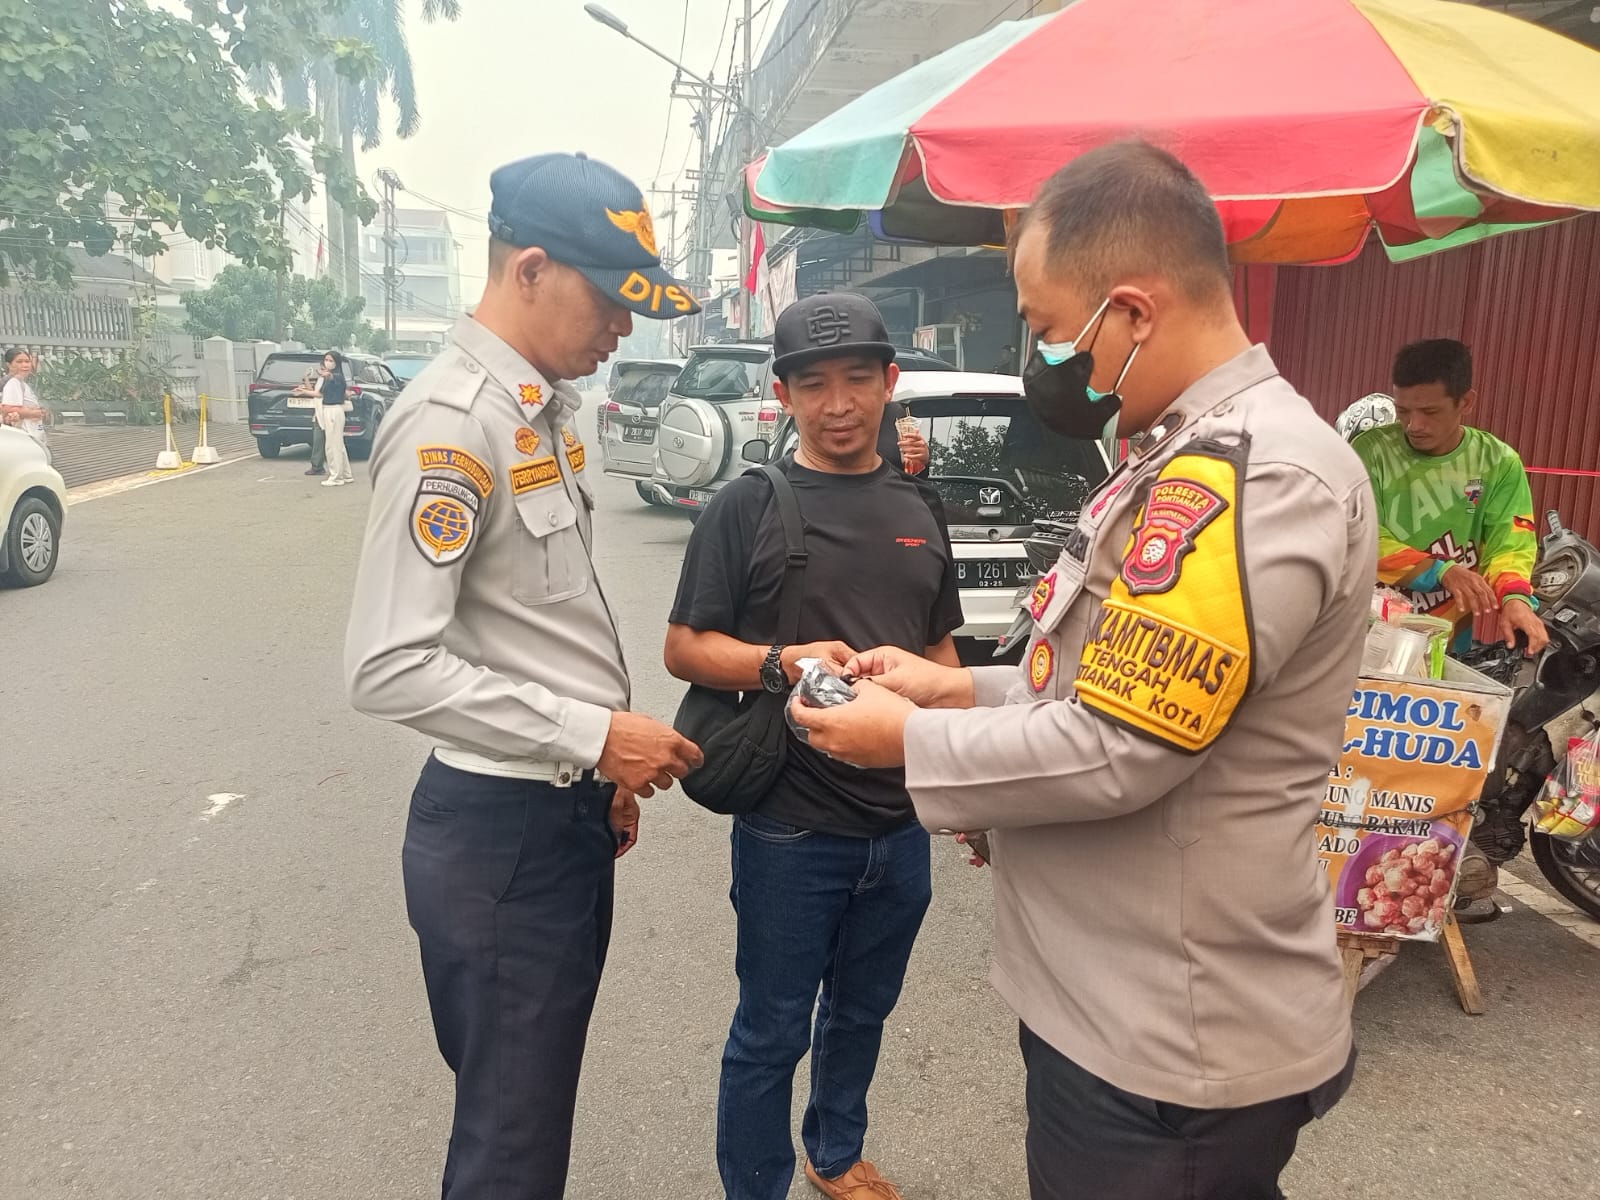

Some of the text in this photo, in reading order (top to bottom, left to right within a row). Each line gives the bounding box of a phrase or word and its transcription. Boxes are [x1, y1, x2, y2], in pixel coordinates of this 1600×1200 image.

[422, 450, 449, 465] DINAS
[425, 480, 479, 509] PERHUBUNGAN
[1155, 485, 1210, 509] POLRESTA
[1156, 495, 1201, 511] PONTIANAK
[953, 562, 967, 580] B
[976, 562, 1008, 580] 1261
[1089, 648, 1172, 693] TENGAH
[1147, 697, 1202, 733] KOTA
[1370, 791, 1434, 813] MANIS
[1365, 815, 1431, 837] BAKAR
